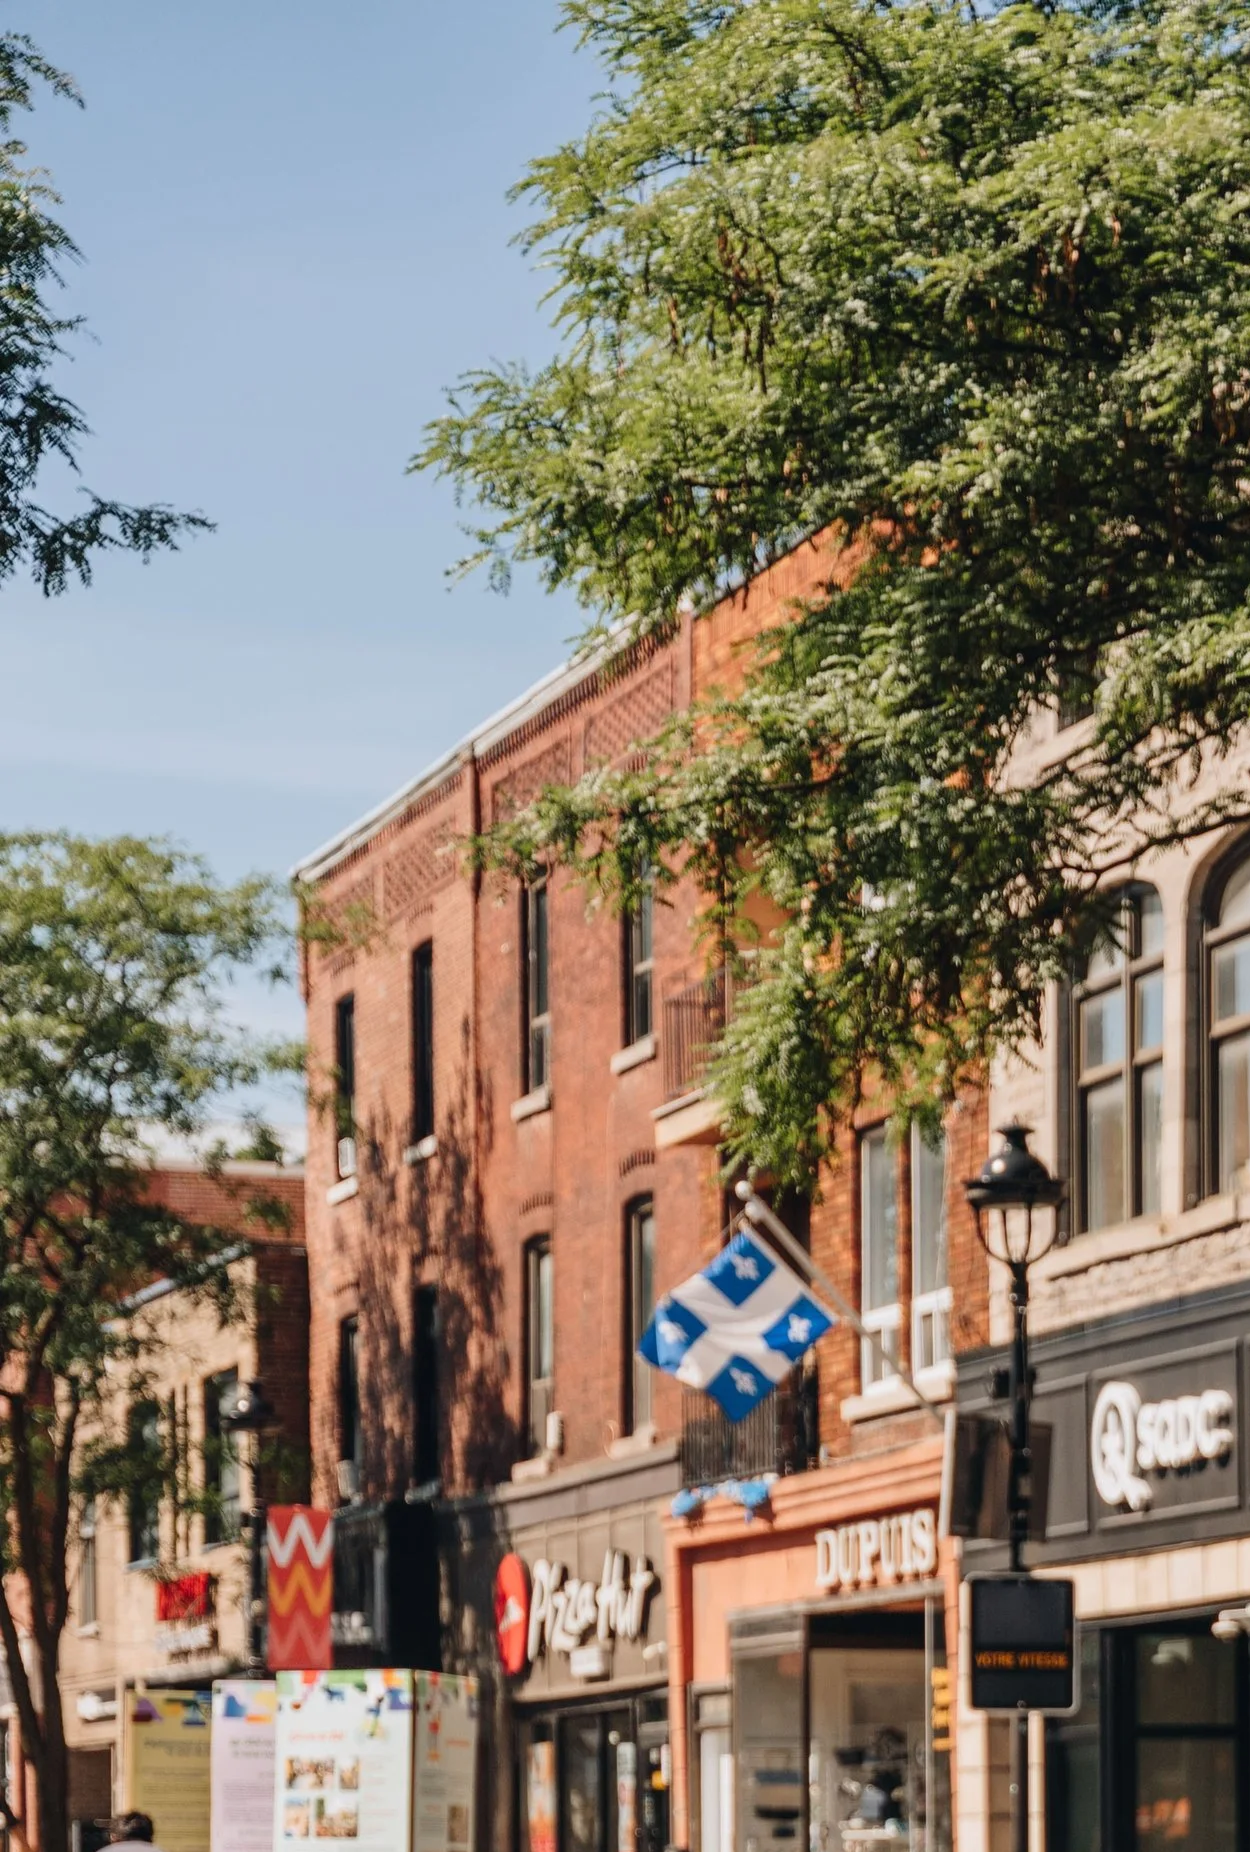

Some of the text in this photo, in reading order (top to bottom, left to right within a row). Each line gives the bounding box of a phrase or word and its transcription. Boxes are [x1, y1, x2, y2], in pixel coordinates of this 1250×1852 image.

[815, 1507, 937, 1588] DUPUIS
[527, 1547, 654, 1661] Pizza Hut
[975, 1651, 1068, 1670] VOTRE VITESSE
